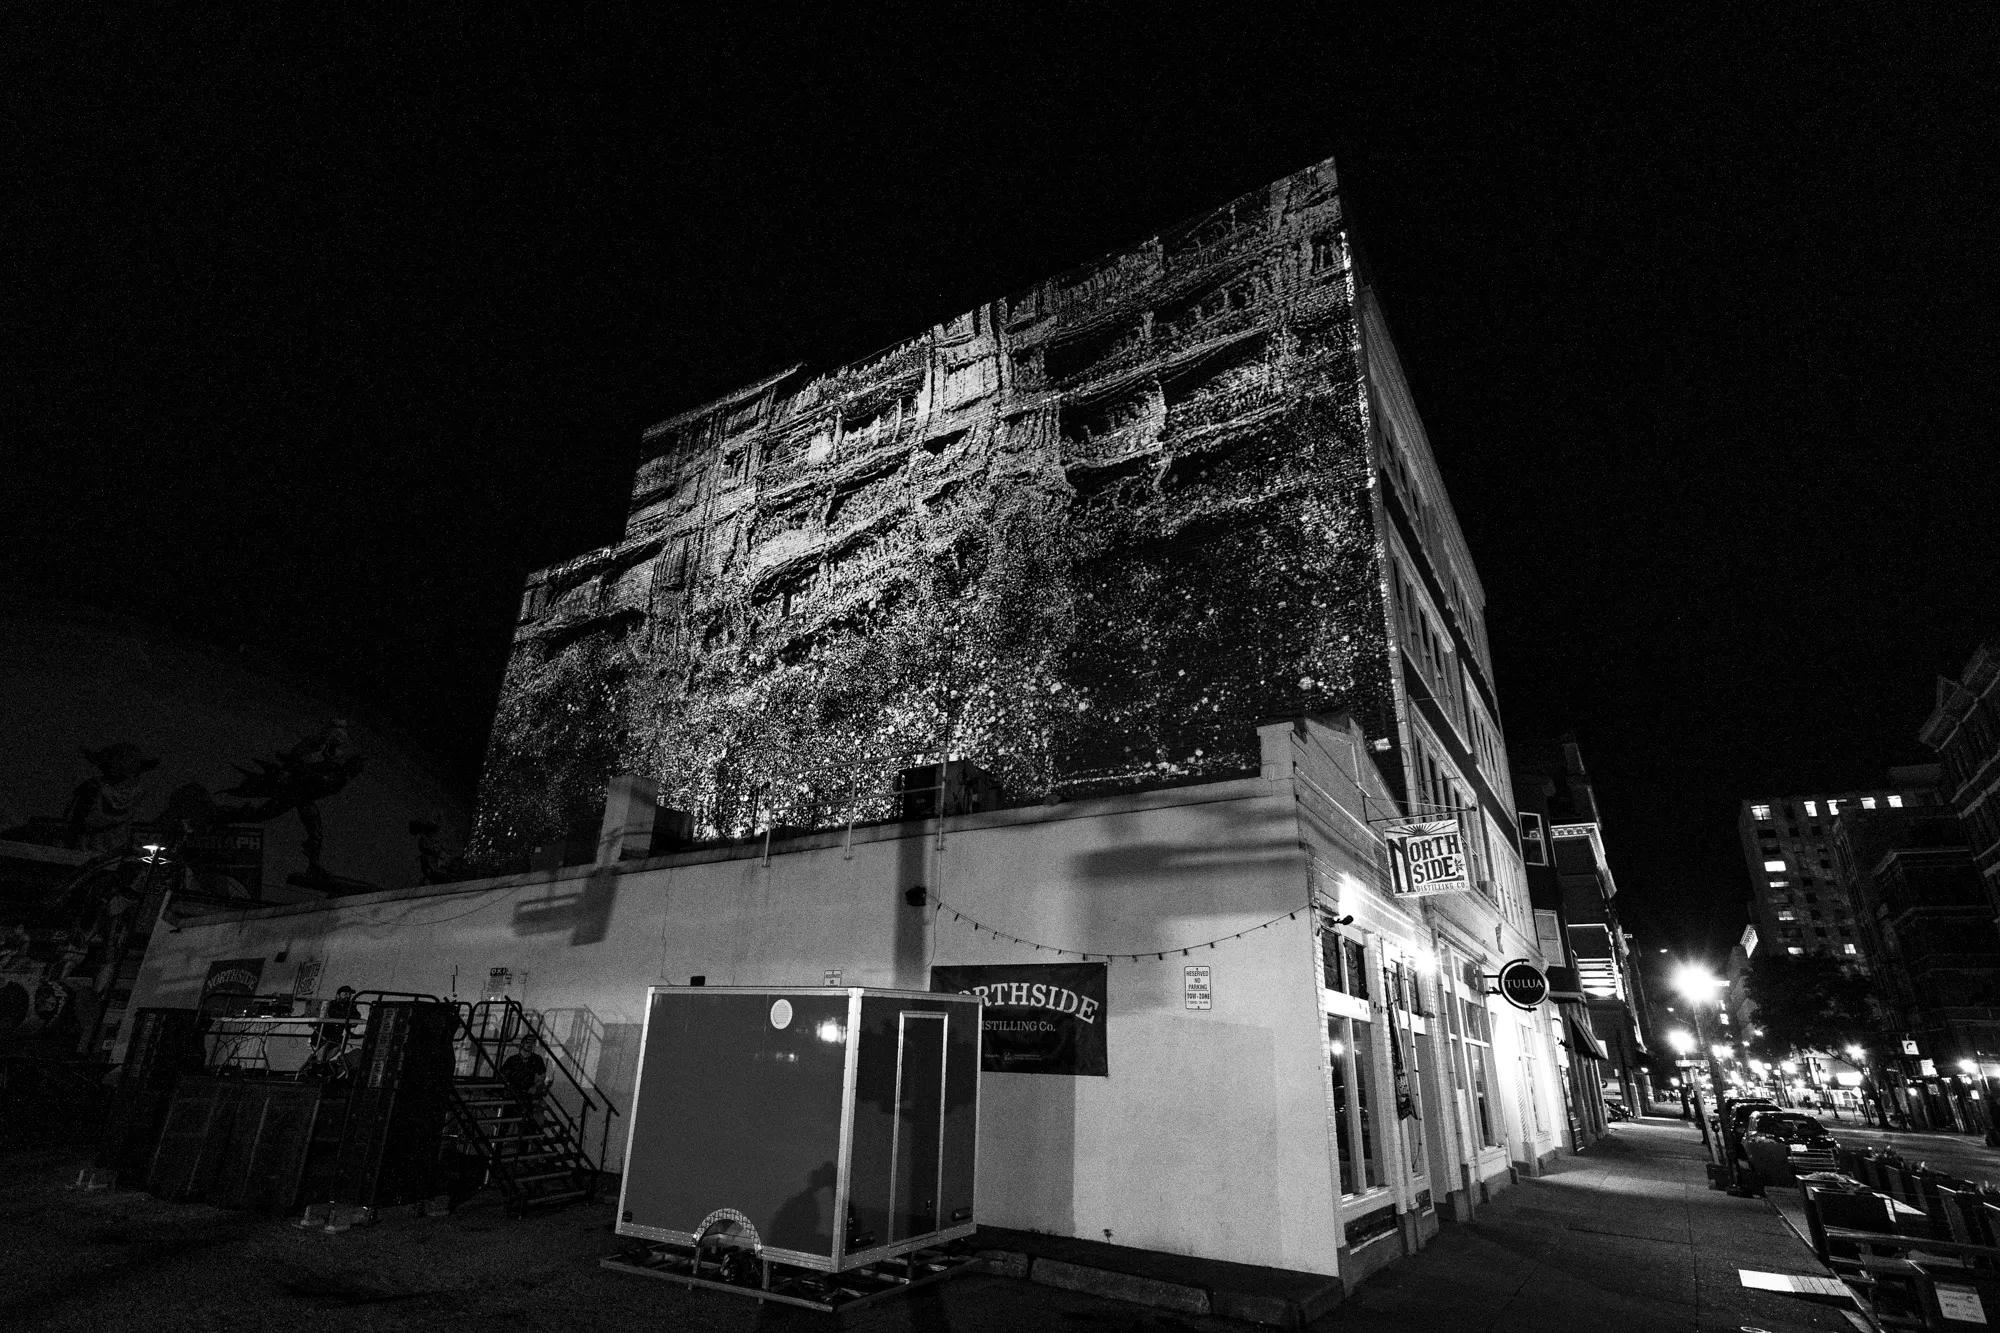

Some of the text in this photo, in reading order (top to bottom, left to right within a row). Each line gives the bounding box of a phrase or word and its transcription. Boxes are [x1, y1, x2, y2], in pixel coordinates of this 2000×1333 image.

[1386, 834, 1462, 893] NORTH
[1413, 856, 1456, 884] SIDE
[1416, 883, 1453, 892] DISTILLING
[205, 969, 259, 992] NORTHSIDE
[1505, 979, 1544, 989] TULUA
[958, 982, 1099, 1025] RTHSIDE
[982, 1020, 1056, 1032] ISTILLING Co.
